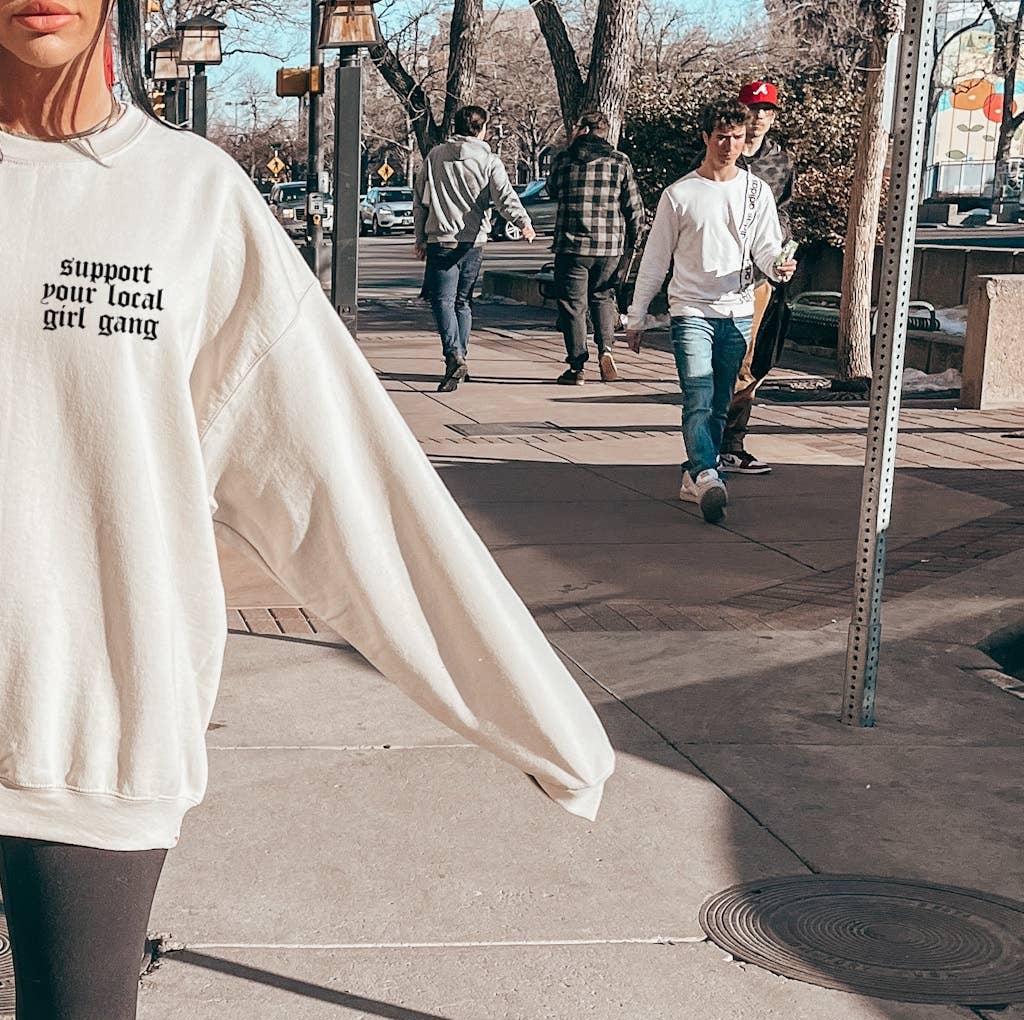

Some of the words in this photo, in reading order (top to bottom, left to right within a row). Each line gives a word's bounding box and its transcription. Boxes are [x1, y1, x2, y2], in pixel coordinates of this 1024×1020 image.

[60, 257, 152, 284] support
[40, 283, 97, 304] your
[108, 284, 164, 311] local
[42, 304, 86, 331] girl
[98, 314, 159, 341] gang
